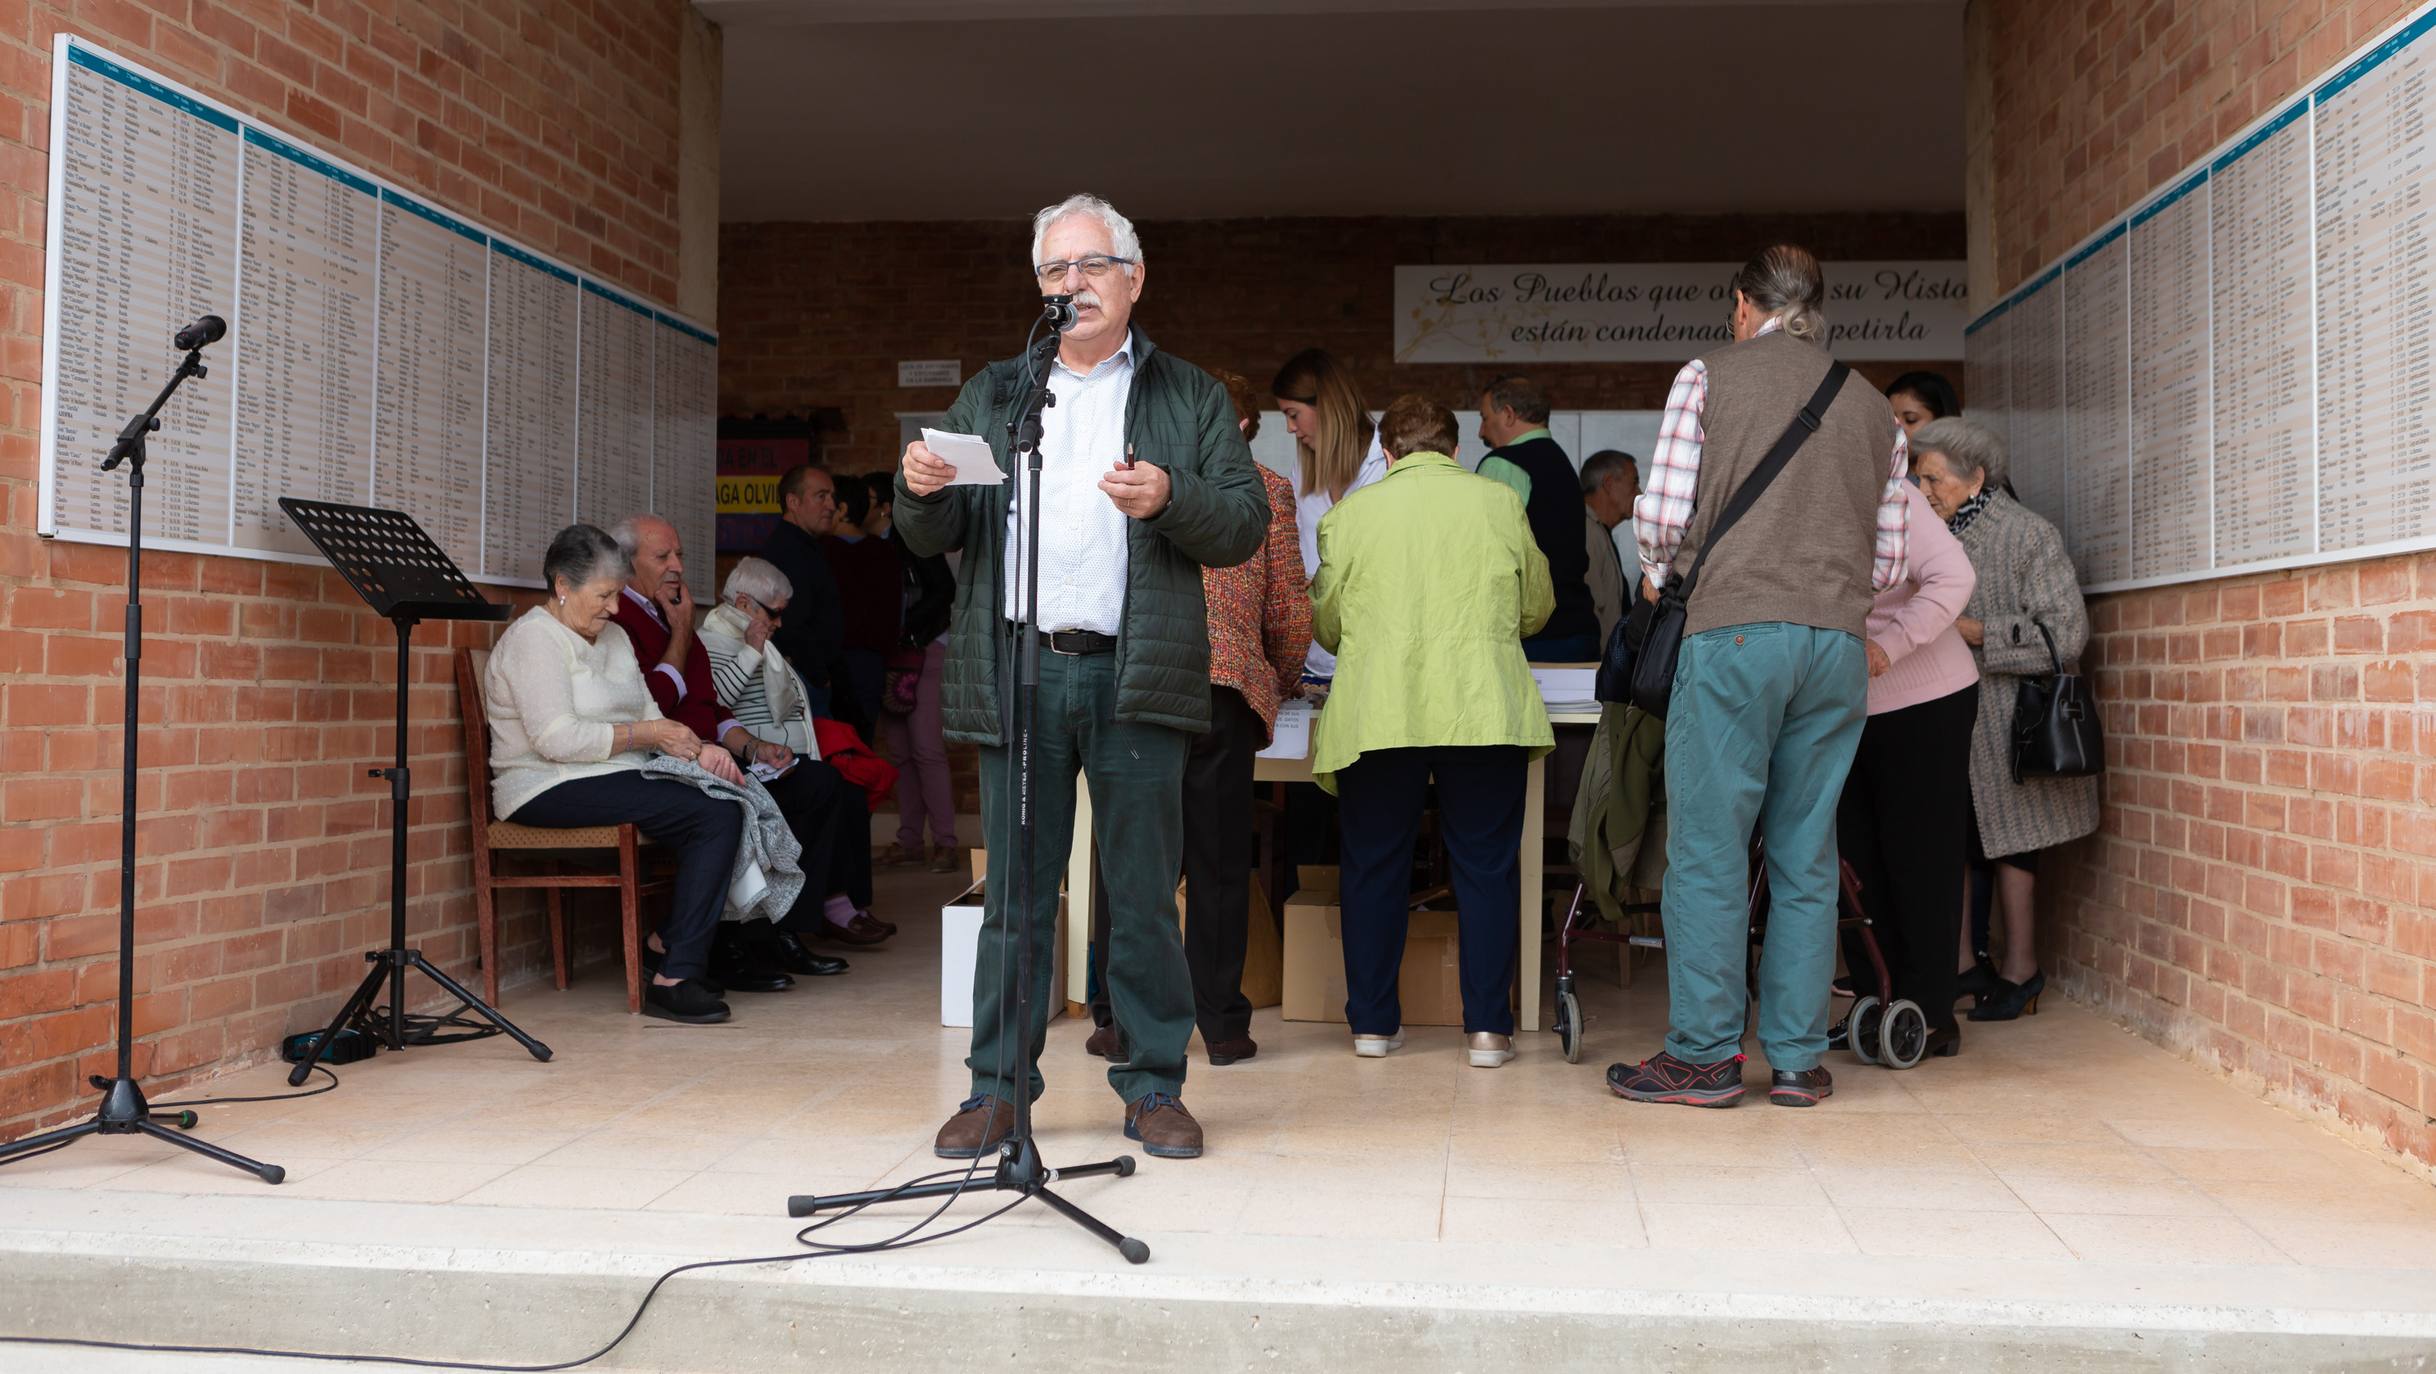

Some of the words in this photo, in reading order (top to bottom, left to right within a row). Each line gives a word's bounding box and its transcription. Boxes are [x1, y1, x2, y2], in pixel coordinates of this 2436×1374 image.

[1429, 271, 1502, 305] Los
[1508, 271, 1643, 304] Pueblos
[1649, 283, 1702, 313] que
[1829, 281, 1867, 302] su
[1511, 320, 1587, 343] están
